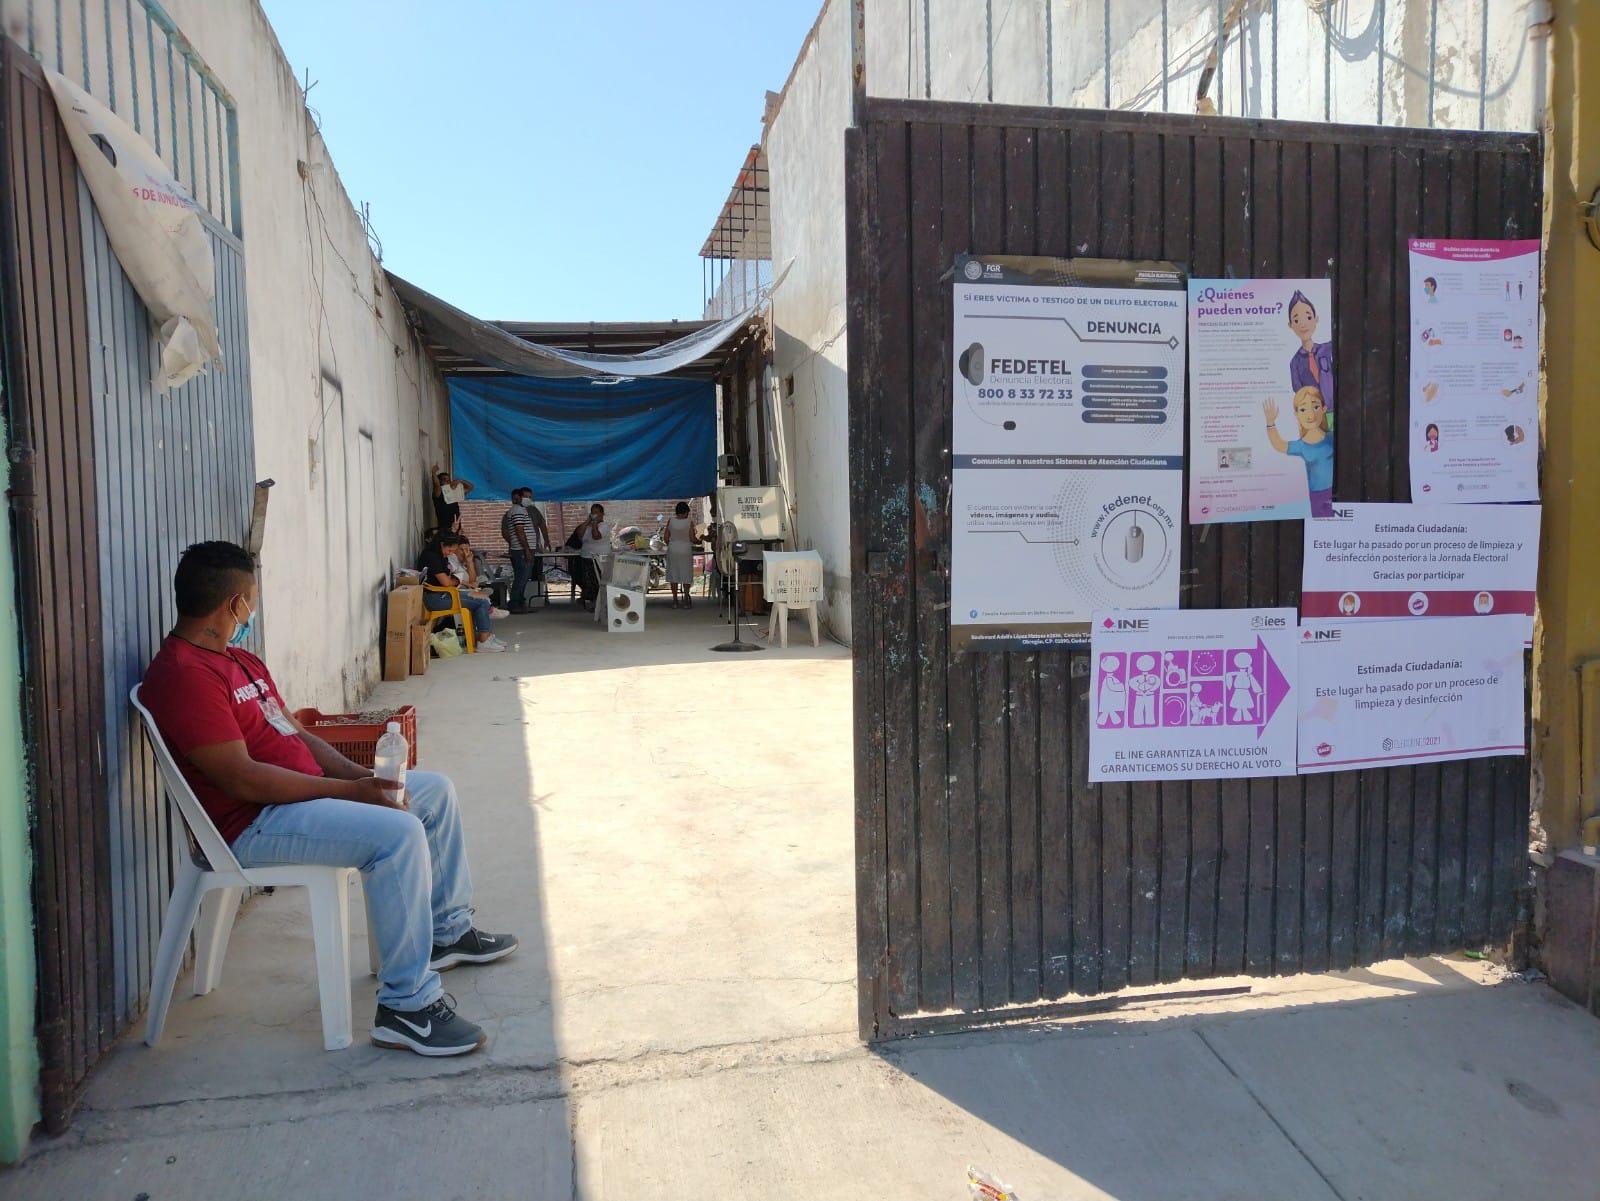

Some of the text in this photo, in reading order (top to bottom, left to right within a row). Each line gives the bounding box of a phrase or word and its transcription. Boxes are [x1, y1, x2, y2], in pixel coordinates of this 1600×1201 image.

[142, 188, 156, 201] DE
[986, 264, 1001, 272] FGR
[974, 294, 994, 302] ERES
[1104, 298, 1132, 306] DELITO
[1134, 299, 1178, 308] ELECTORAL
[1197, 287, 1254, 303] ¿Quiénes
[1197, 302, 1283, 318] pueden votar?
[1087, 321, 1161, 334] DENUNCIA
[990, 358, 1072, 375] FEDETEL
[990, 375, 1072, 385] Denuncia Electoral
[978, 388, 1072, 400] 800 8 33 72 33
[1023, 457, 1054, 465] nuestros
[1055, 457, 1087, 465] Sistemas
[1130, 458, 1168, 466] Ciudadana
[995, 511, 1028, 519] imágenes
[1091, 495, 1175, 538] www.fedenet.org.mx
[1333, 509, 1354, 518] NE
[1374, 523, 1468, 533] Estimada Ciudadanía:
[1313, 540, 1332, 549] Este
[1333, 539, 1357, 550] lugar
[1358, 540, 1370, 549] ha
[1371, 540, 1403, 550] pasado
[1404, 542, 1419, 551] por
[1433, 542, 1466, 551] proceso
[1467, 540, 1478, 549] de
[1479, 540, 1515, 551] limpieza
[1516, 543, 1523, 551] y
[1325, 553, 1381, 562] desinfección
[1382, 553, 1421, 563] posterior
[1429, 553, 1437, 562] la
[1438, 553, 1471, 562] Jornada
[1473, 553, 1509, 562] Electoral
[1373, 570, 1465, 581] Gracias por participar
[1117, 619, 1149, 629] INE
[1265, 616, 1286, 626] iees
[1315, 629, 1341, 640] INE
[1357, 659, 1463, 675] Estimada Ciudadanía:
[1316, 675, 1499, 698] Este lugar ha pasado por un proceso de
[1355, 693, 1463, 711] limpieza y desinfección
[1115, 746, 1268, 760] EL INE GARANTIZA LA INCLUSIÓN
[1101, 759, 1282, 774] GARANTICEMOS SU DERECHO AL VOTO
